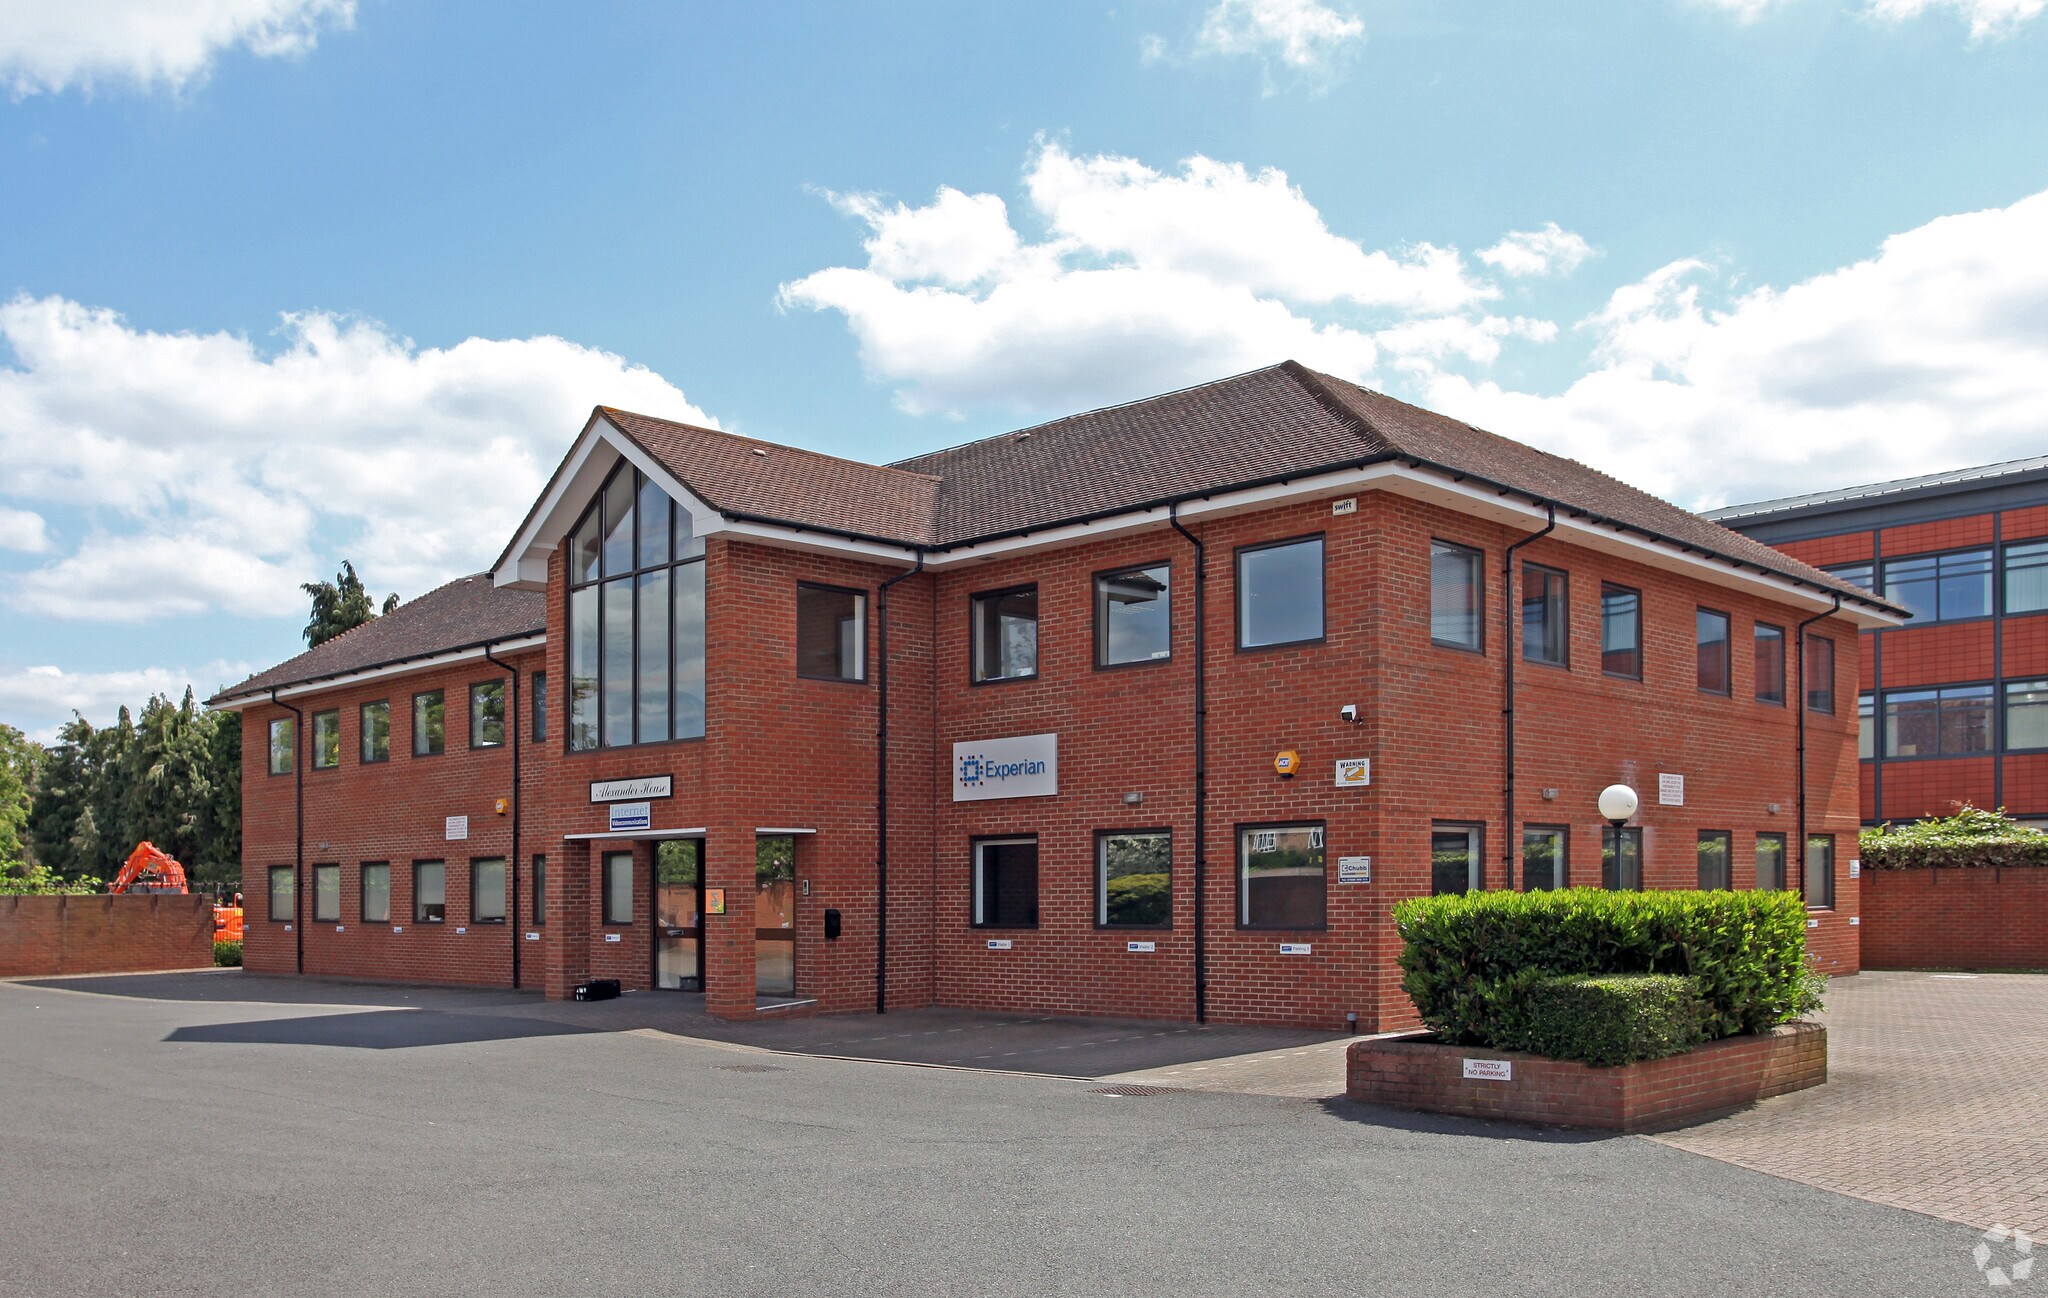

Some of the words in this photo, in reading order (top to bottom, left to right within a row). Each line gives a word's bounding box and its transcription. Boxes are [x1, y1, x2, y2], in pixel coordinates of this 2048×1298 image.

[1334, 500, 1351, 511] swift
[986, 759, 1045, 781] Experian
[596, 784, 637, 797] Alexander
[640, 781, 667, 793] House
[611, 806, 648, 817] Internet
